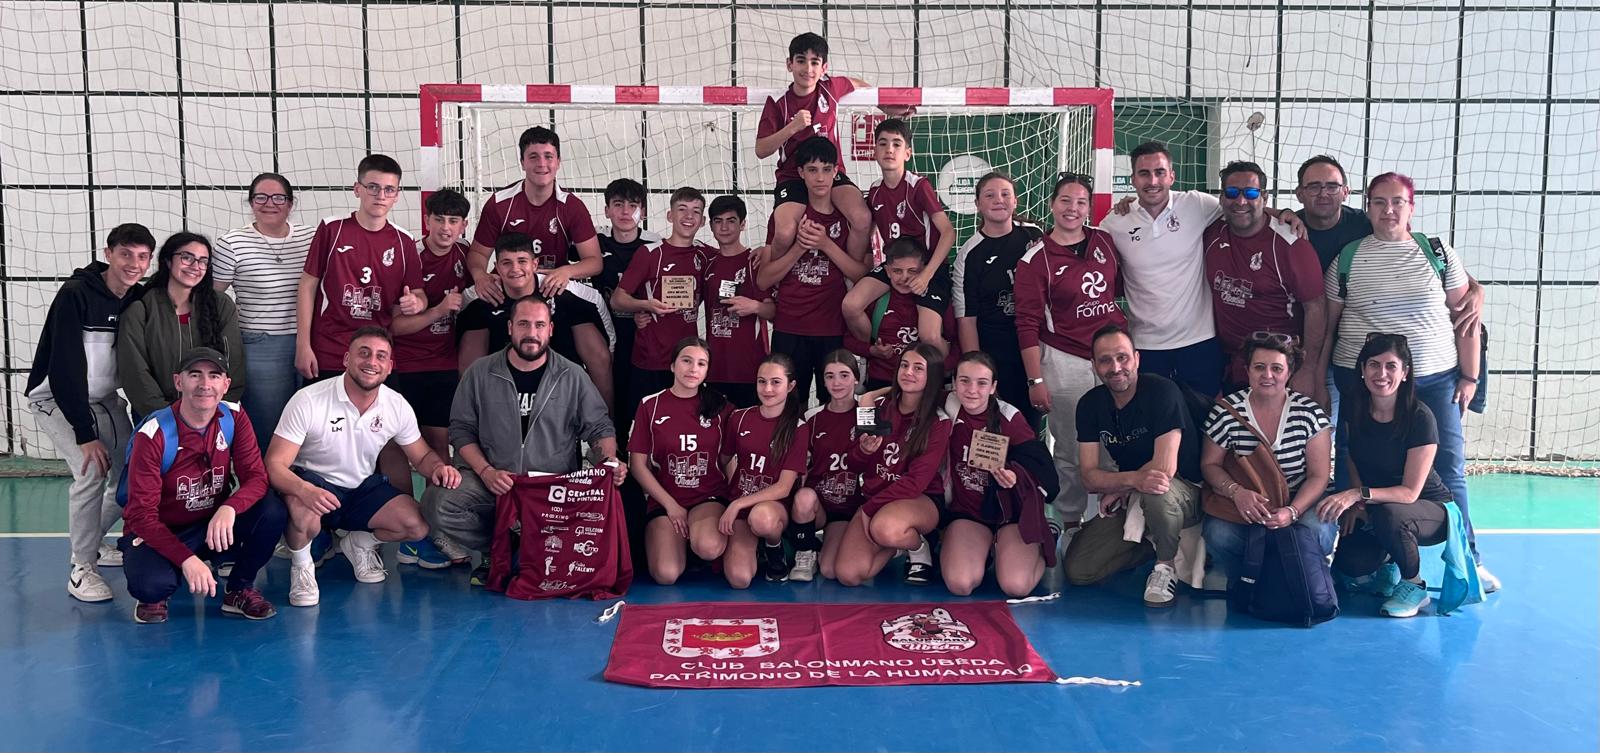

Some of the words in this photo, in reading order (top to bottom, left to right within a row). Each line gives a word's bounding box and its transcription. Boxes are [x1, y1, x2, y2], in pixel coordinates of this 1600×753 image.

[780, 188, 788, 198] 5
[360, 266, 372, 284] 3
[1076, 301, 1115, 319] Forma
[679, 434, 698, 452] 15
[750, 453, 767, 474] 14
[568, 489, 605, 498] CENTRAL
[650, 671, 801, 681] PATRIMONIO
[809, 669, 841, 679] DE
[849, 670, 881, 678] LA
[887, 663, 1033, 678] HUMANIDAD
[681, 661, 745, 670] CLUB
[760, 658, 913, 669] BALONMANO
